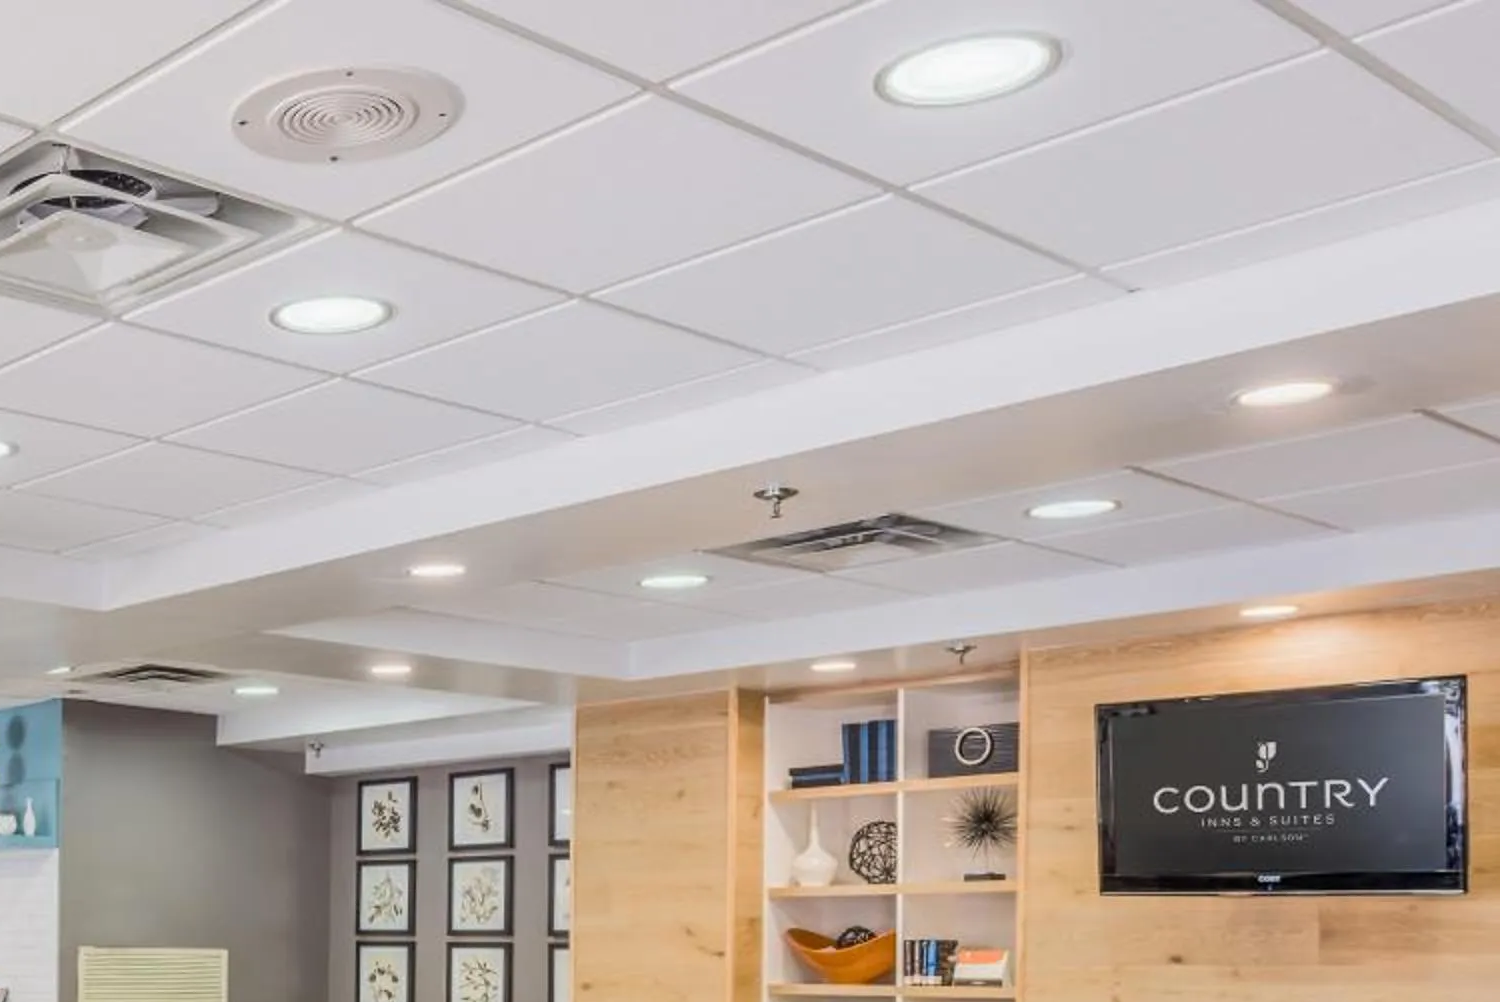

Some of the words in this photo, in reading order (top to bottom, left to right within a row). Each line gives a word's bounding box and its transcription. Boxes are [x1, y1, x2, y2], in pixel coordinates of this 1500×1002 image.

[1201, 816, 1242, 828] INNS
[1250, 816, 1261, 827] &
[1269, 813, 1336, 826] SUITES
